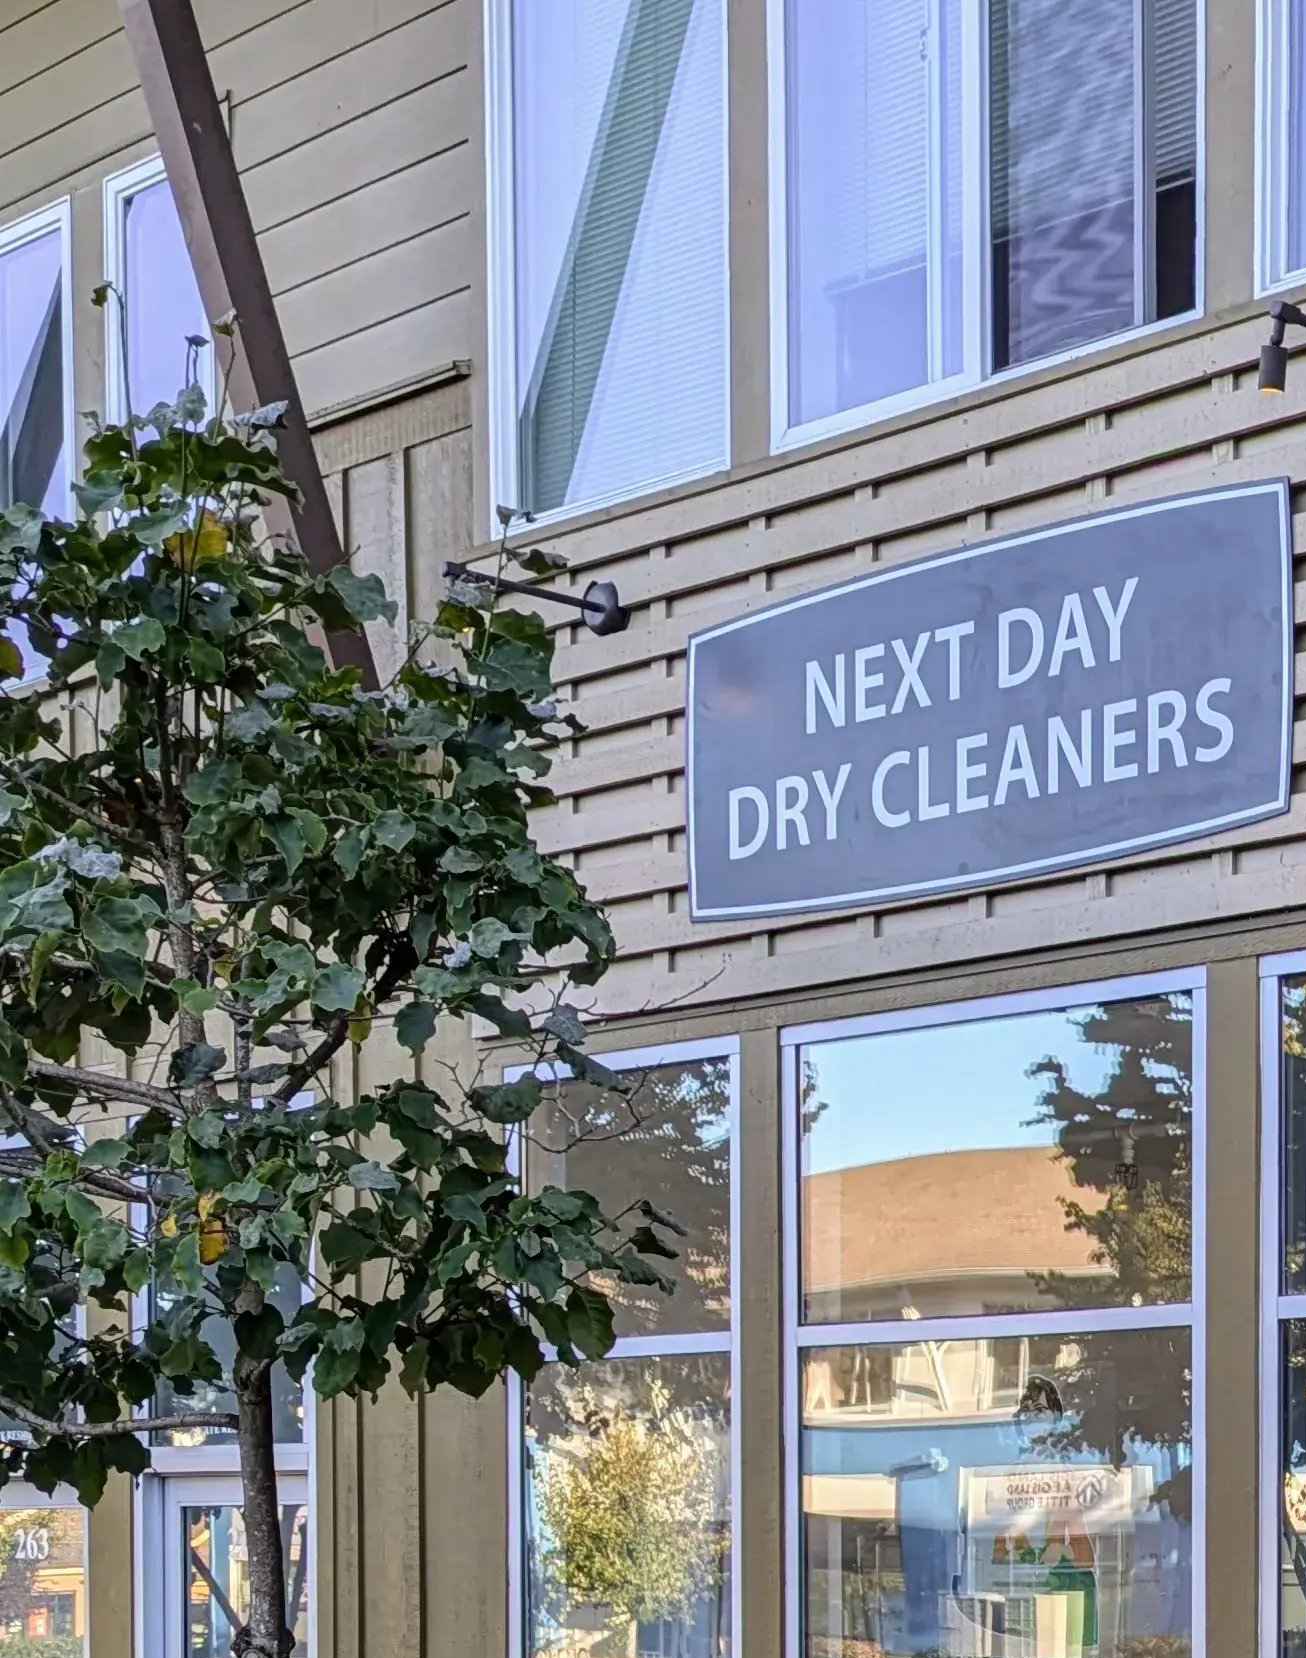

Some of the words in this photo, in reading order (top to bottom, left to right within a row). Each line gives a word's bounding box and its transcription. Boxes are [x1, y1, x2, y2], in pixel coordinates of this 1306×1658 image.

[805, 620, 975, 735] NEXT
[997, 576, 1139, 690] DAY
[728, 762, 852, 861] DRY
[871, 677, 1235, 828] CLEANERS
[14, 1525, 49, 1560] 263
